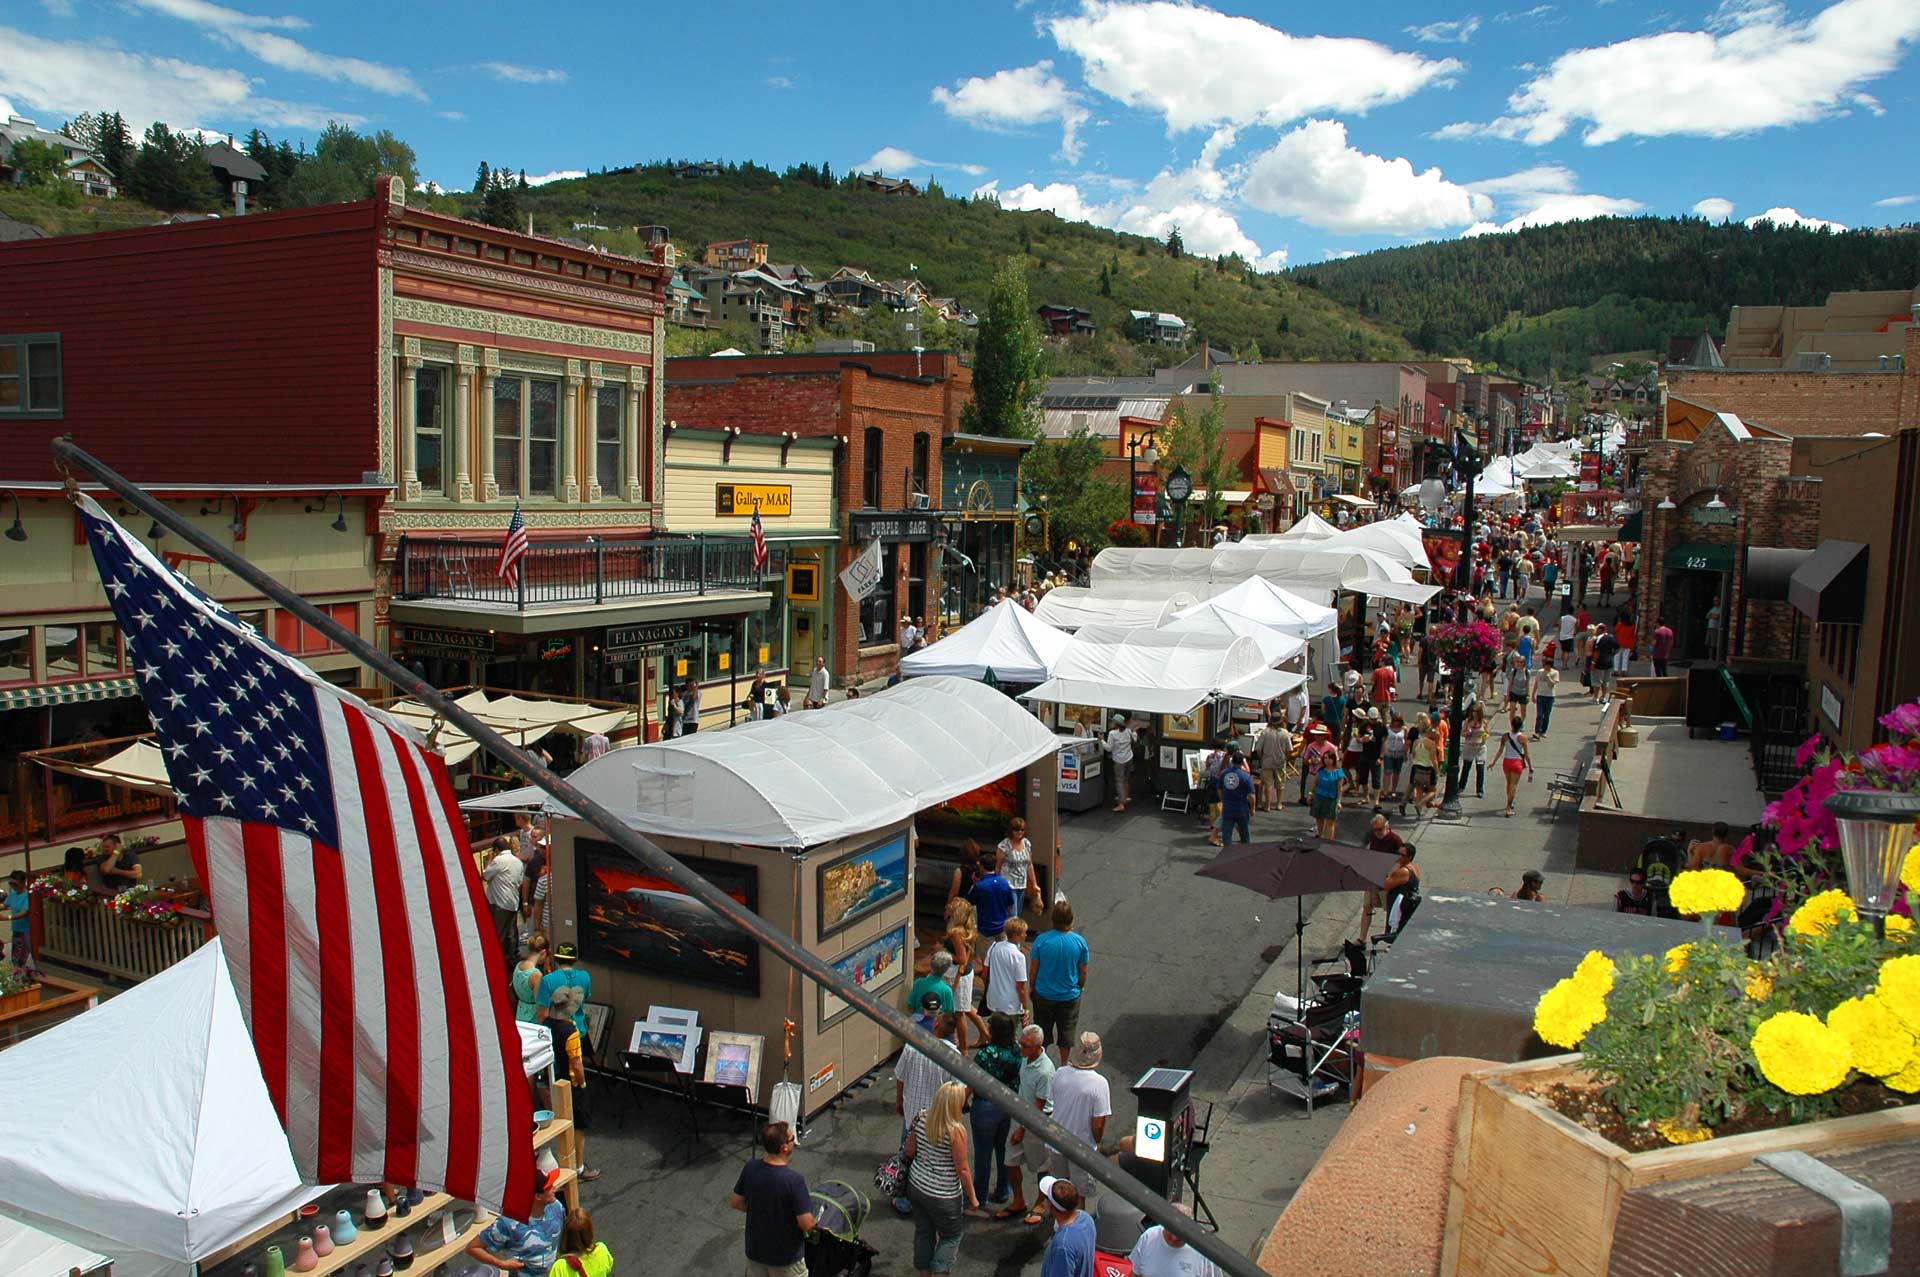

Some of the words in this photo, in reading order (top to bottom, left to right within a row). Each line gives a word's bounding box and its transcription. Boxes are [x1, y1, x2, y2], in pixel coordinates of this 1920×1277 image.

[766, 492, 789, 506] MAR
[871, 521, 899, 536] PURPLE
[909, 521, 927, 535] SAGE
[1686, 556, 1707, 568] 425
[412, 630, 485, 647] FLANAGAN'S
[615, 625, 684, 643] FLANAGAN'S
